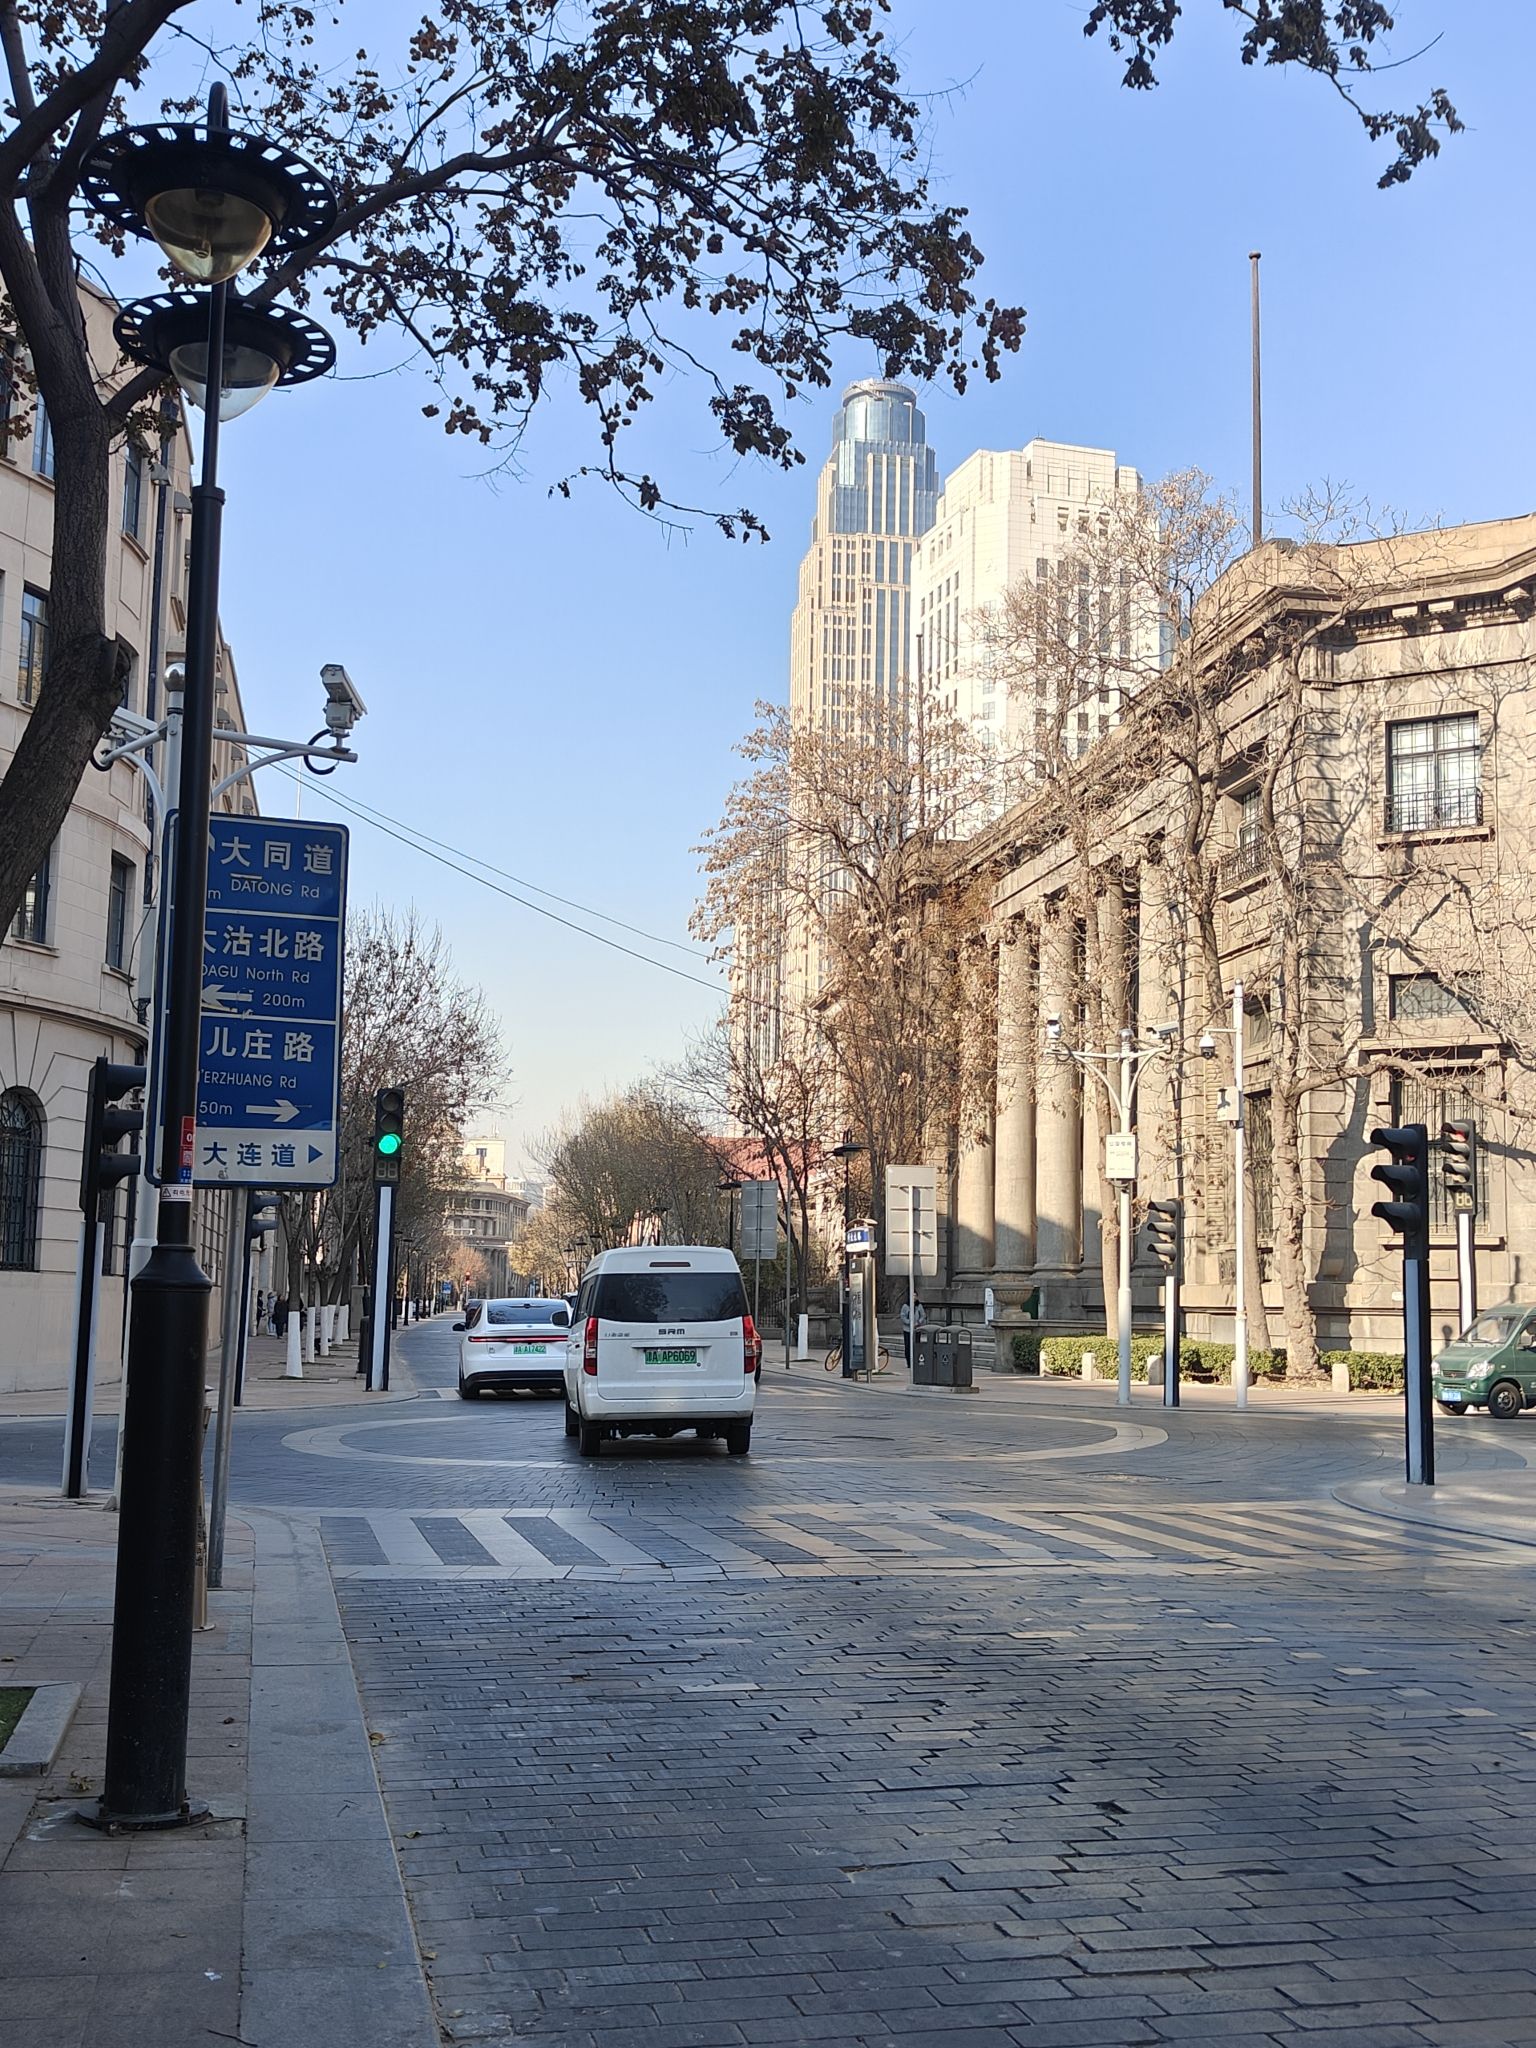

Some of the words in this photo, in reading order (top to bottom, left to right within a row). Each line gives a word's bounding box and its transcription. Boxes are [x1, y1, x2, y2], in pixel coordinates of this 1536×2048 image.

[220, 836, 334, 876] 大同道
[231, 879, 293, 896] DATONG
[301, 885, 320, 899] Rd
[246, 967, 284, 982] North
[292, 970, 310, 984] Rd
[262, 992, 305, 1008] 200m
[206, 1026, 315, 1062] 儿庄路
[198, 1069, 273, 1088] 'ERZHUANG
[279, 1075, 297, 1089] Rd
[203, 1141, 296, 1168] 大连道
